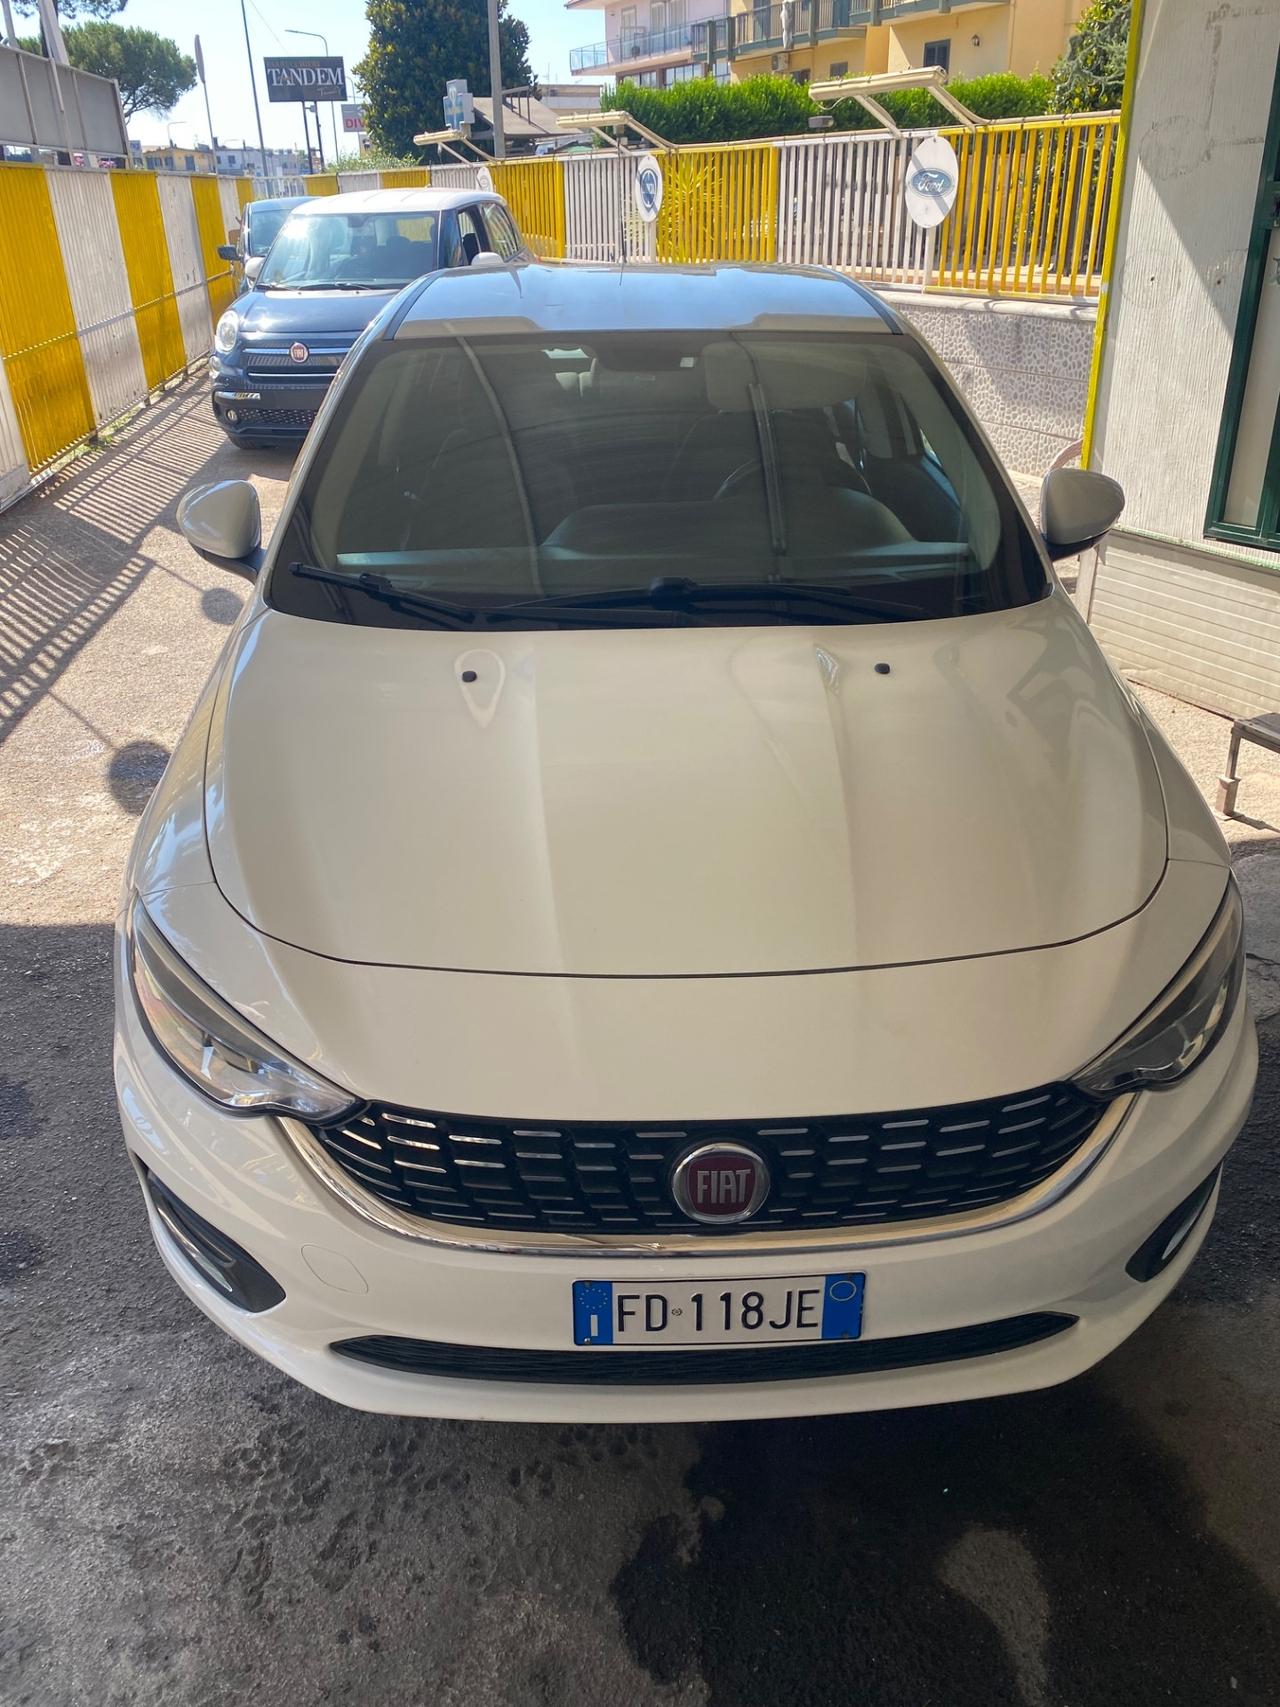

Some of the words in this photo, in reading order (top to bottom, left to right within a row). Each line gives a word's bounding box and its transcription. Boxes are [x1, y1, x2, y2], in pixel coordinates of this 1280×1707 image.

[267, 68, 344, 86] TANDEM
[918, 172, 945, 193] Ford
[697, 1169, 751, 1204] FIAT
